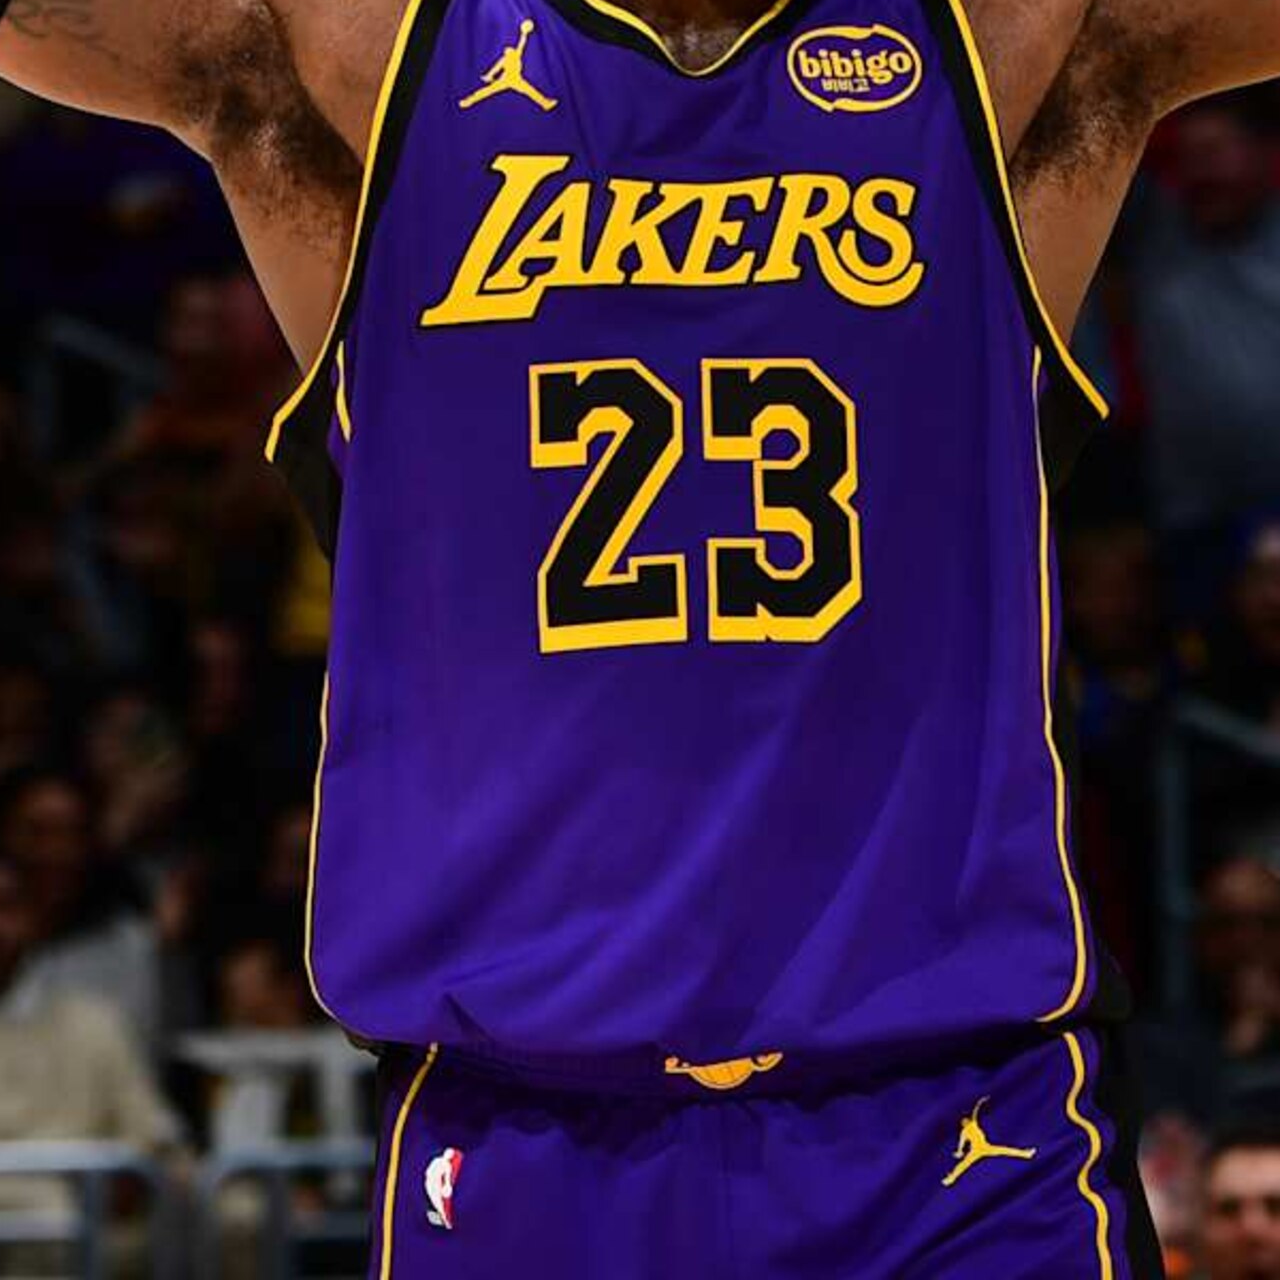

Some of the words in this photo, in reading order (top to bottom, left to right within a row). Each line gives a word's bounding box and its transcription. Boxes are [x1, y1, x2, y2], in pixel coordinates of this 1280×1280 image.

[798, 48, 913, 84] bibigo
[420, 154, 924, 327] LAKERS
[528, 357, 862, 653] 23
